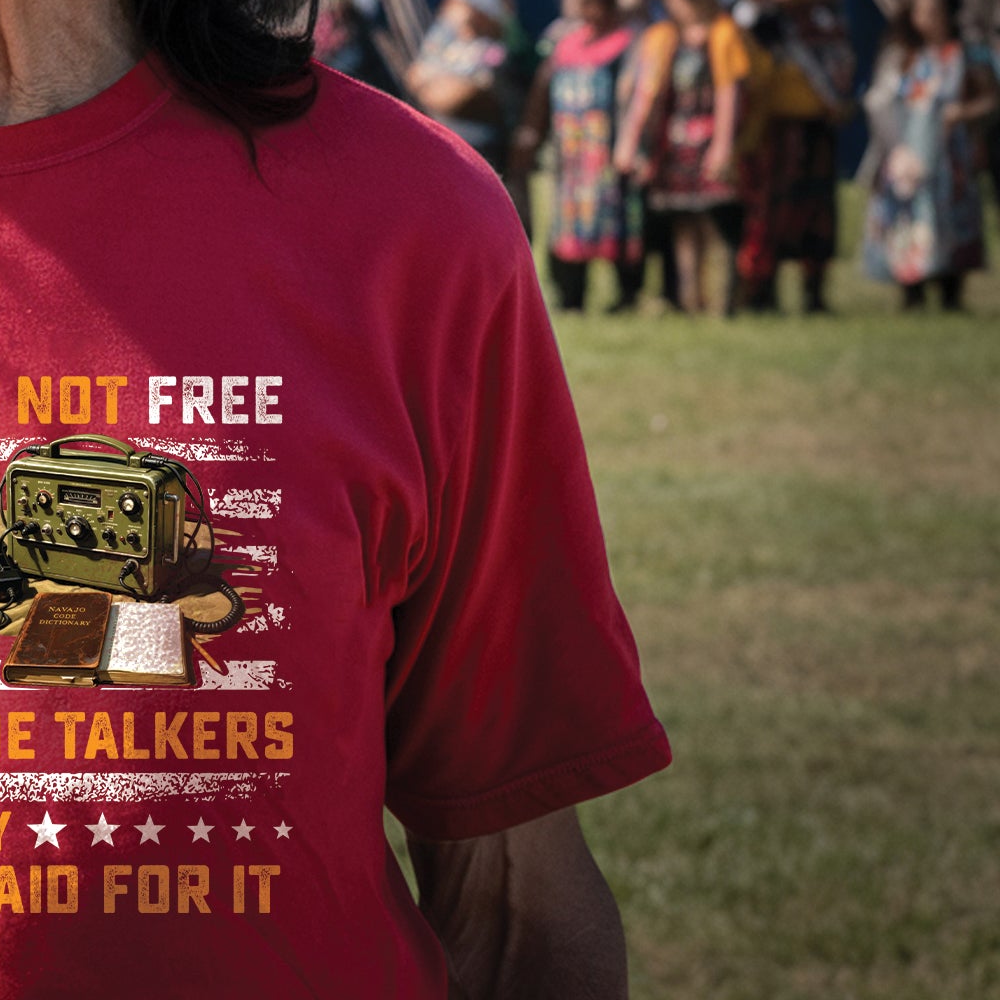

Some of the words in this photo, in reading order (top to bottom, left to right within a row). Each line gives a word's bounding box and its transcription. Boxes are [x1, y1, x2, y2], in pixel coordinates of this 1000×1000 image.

[18, 376, 128, 425] NOT
[148, 376, 283, 425] FREE
[54, 711, 294, 760] TALKERS
[104, 865, 211, 914] FOR
[233, 865, 281, 914] IT
